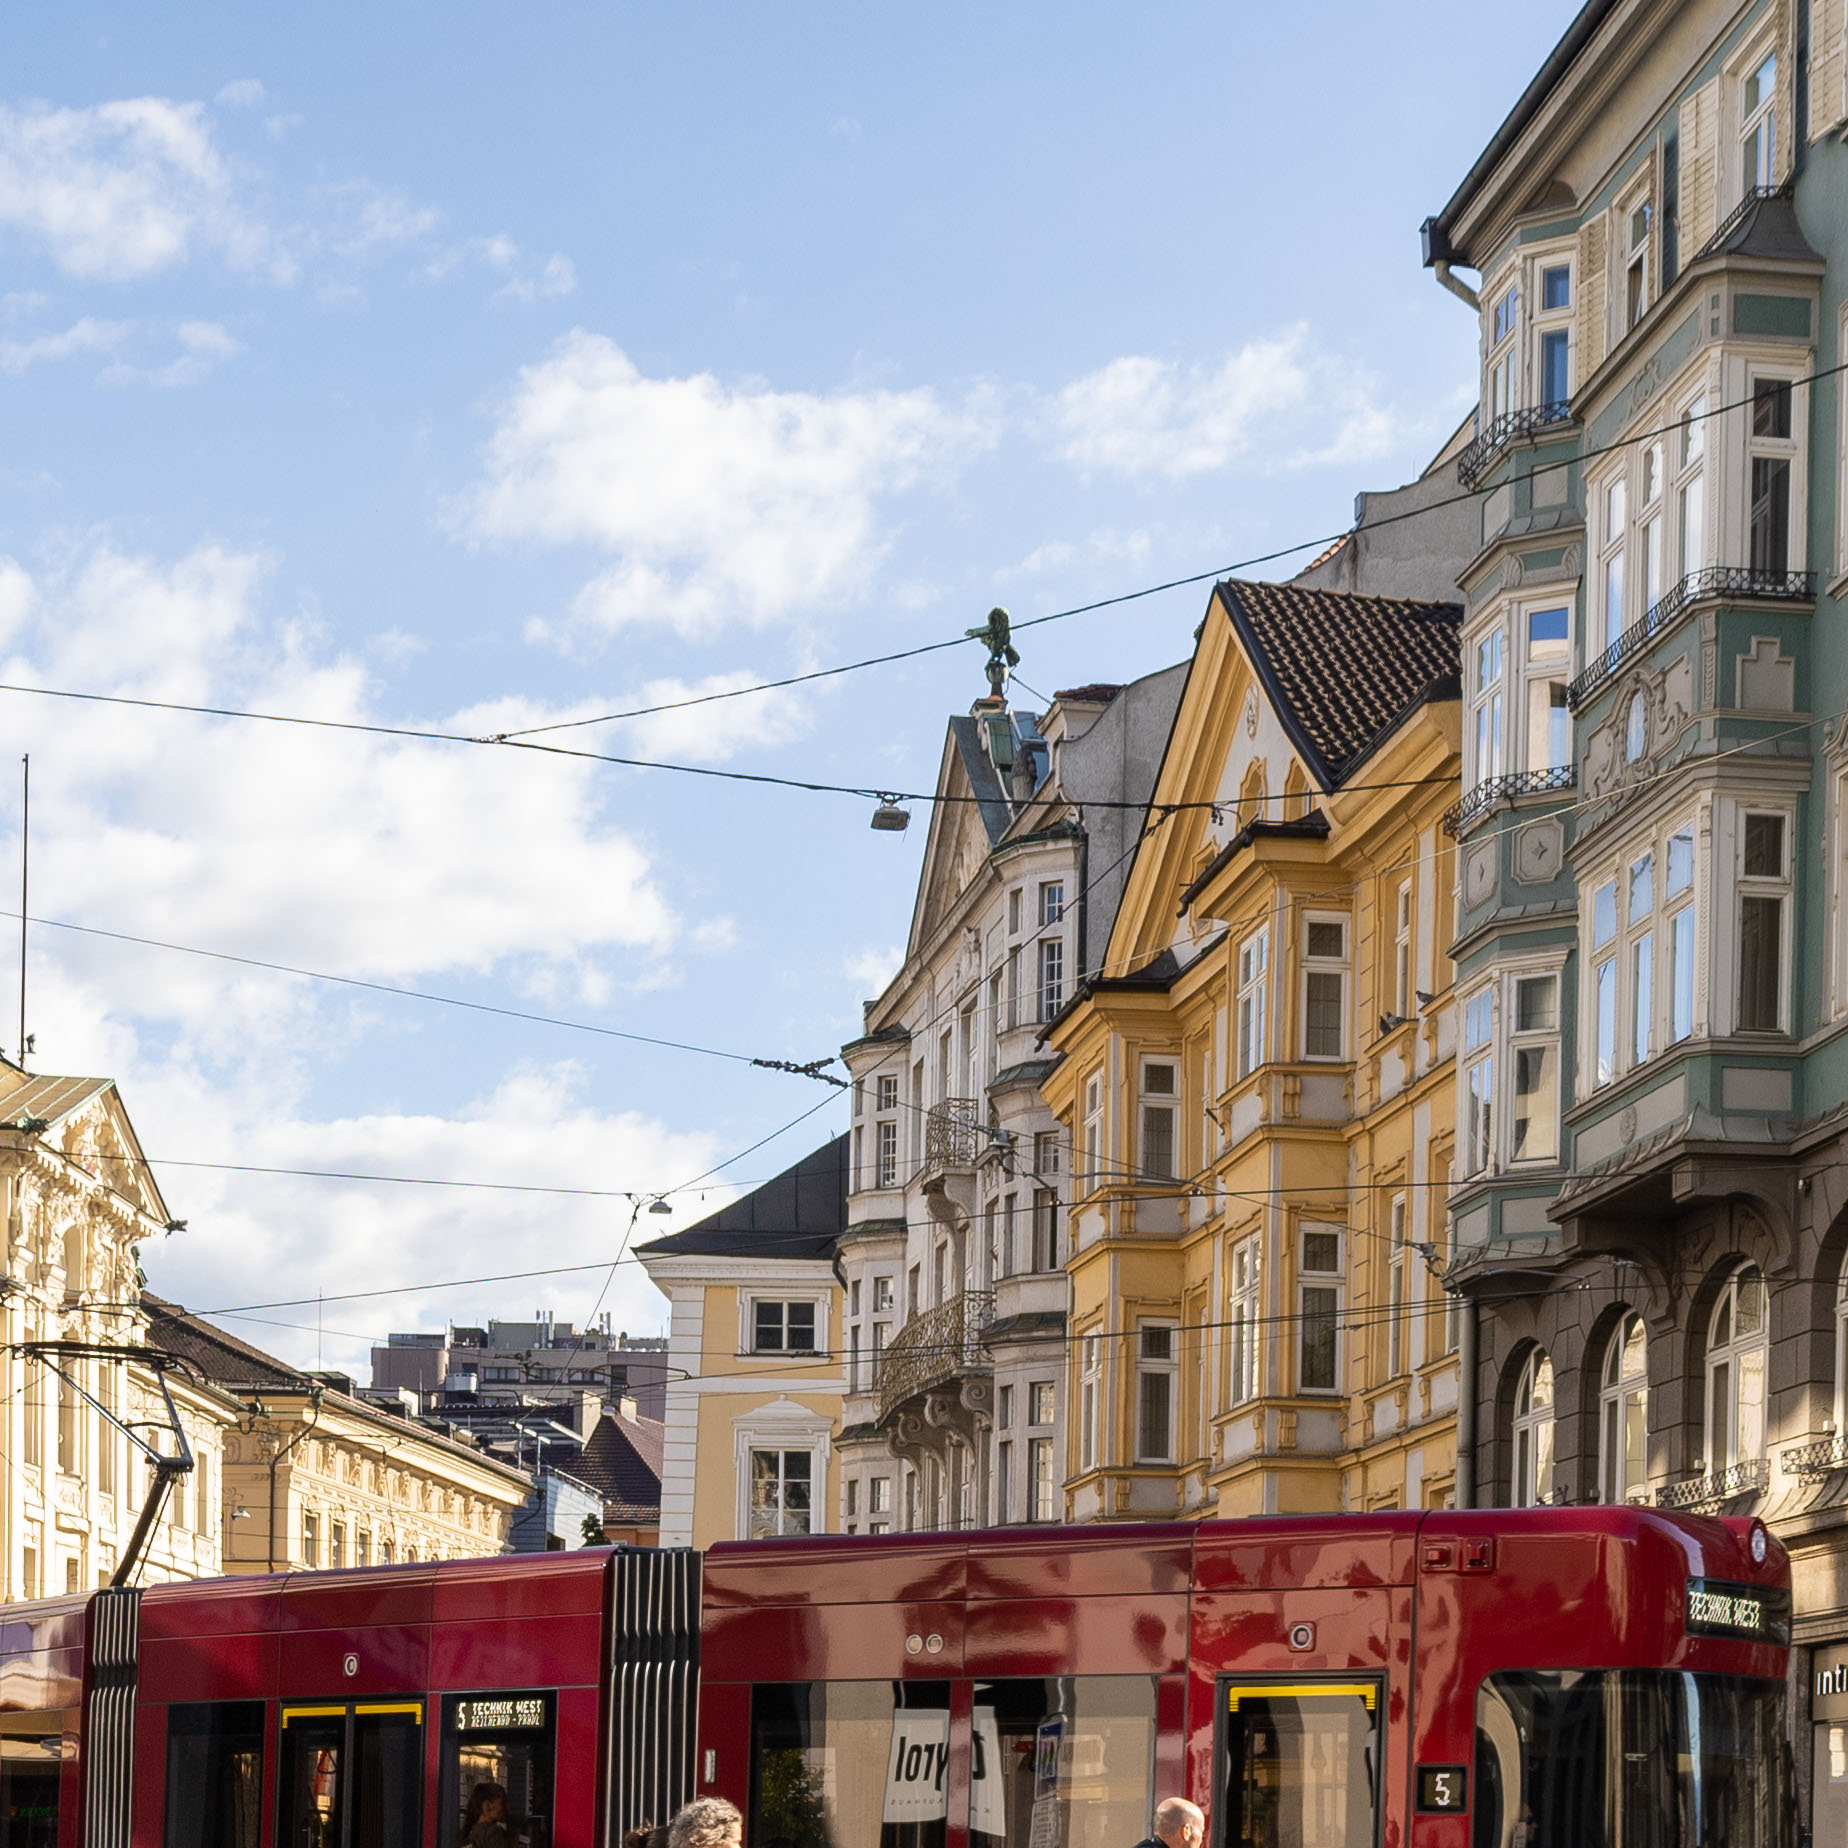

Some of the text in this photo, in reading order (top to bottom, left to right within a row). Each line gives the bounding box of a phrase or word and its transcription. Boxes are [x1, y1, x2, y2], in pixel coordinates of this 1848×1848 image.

[457, 1700, 542, 1730] 5 TECHNIK WEST
[1435, 1773, 1451, 1806] 5
